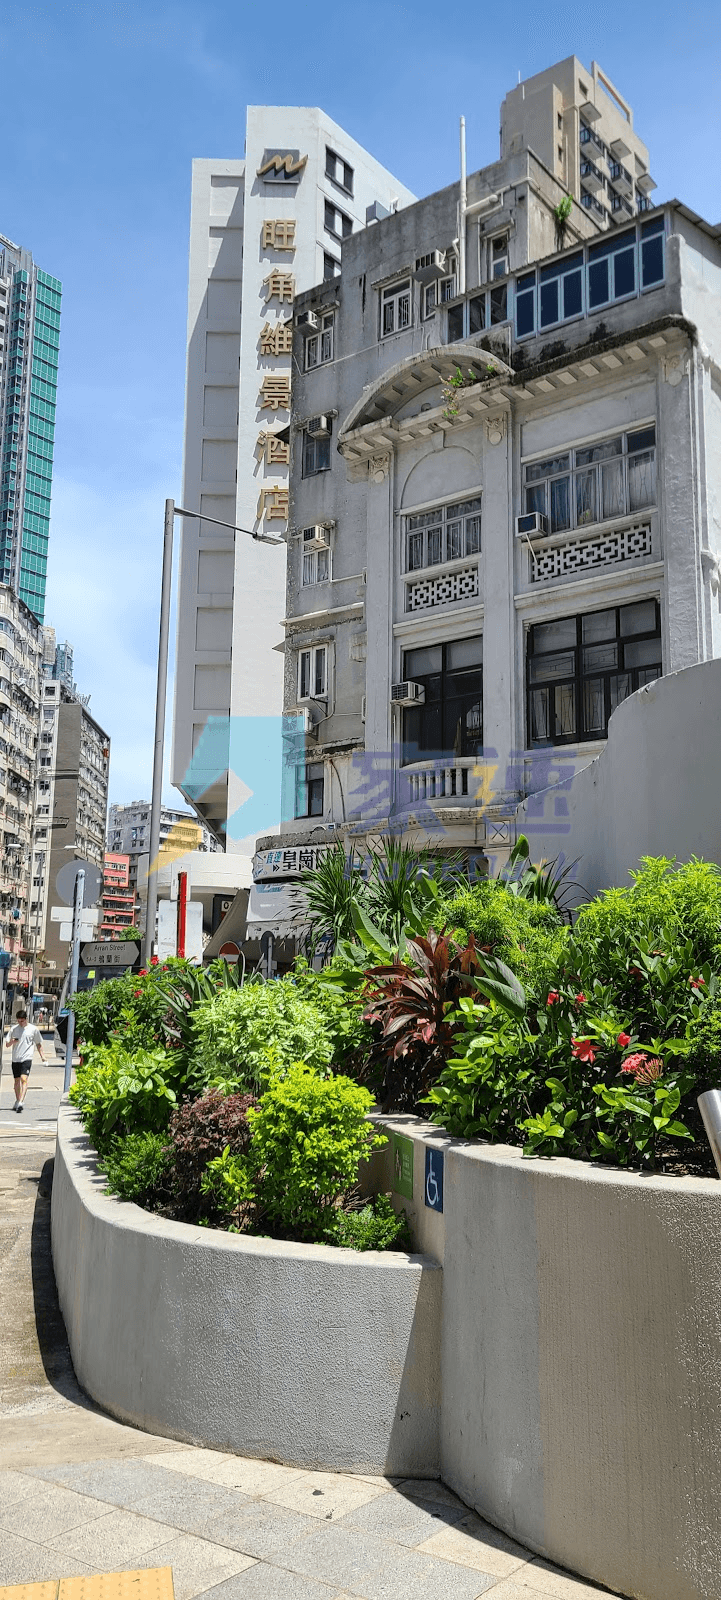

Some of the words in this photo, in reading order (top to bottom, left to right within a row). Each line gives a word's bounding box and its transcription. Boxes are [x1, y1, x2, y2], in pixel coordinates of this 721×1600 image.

[257, 218, 297, 521] 旺角維景酒店
